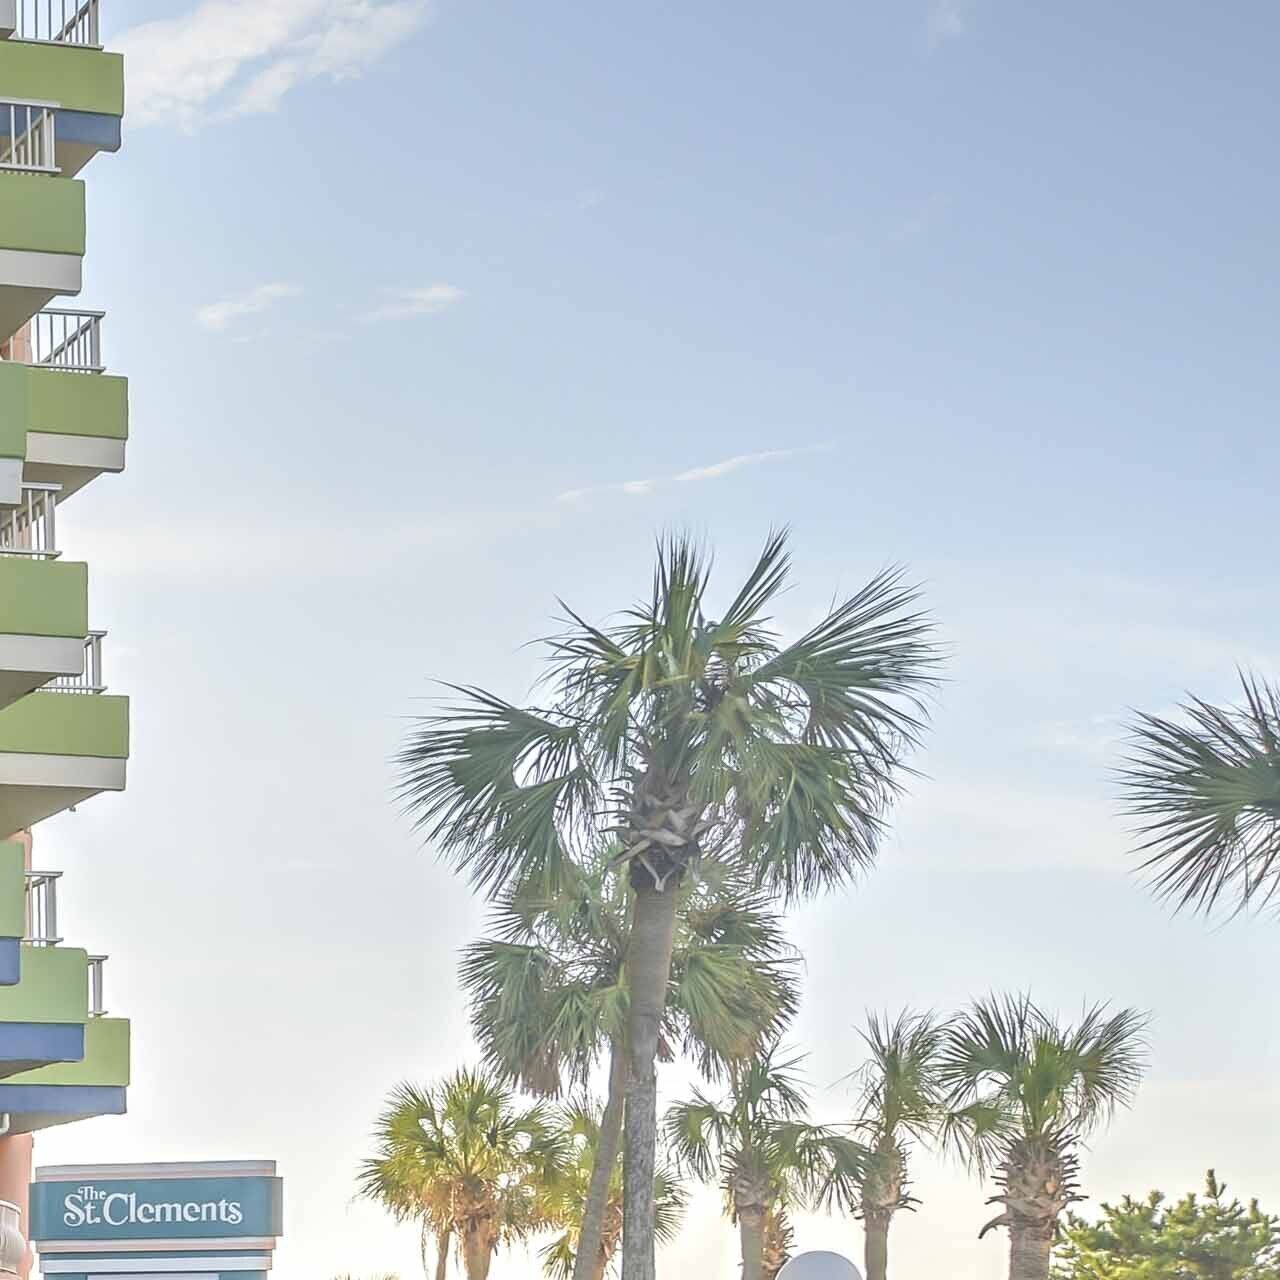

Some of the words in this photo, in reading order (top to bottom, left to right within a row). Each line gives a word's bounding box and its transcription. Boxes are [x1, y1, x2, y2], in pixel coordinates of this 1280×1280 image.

[78, 1186, 107, 1201] The
[63, 1192, 101, 1227] St.
[103, 1191, 243, 1226] Clements
